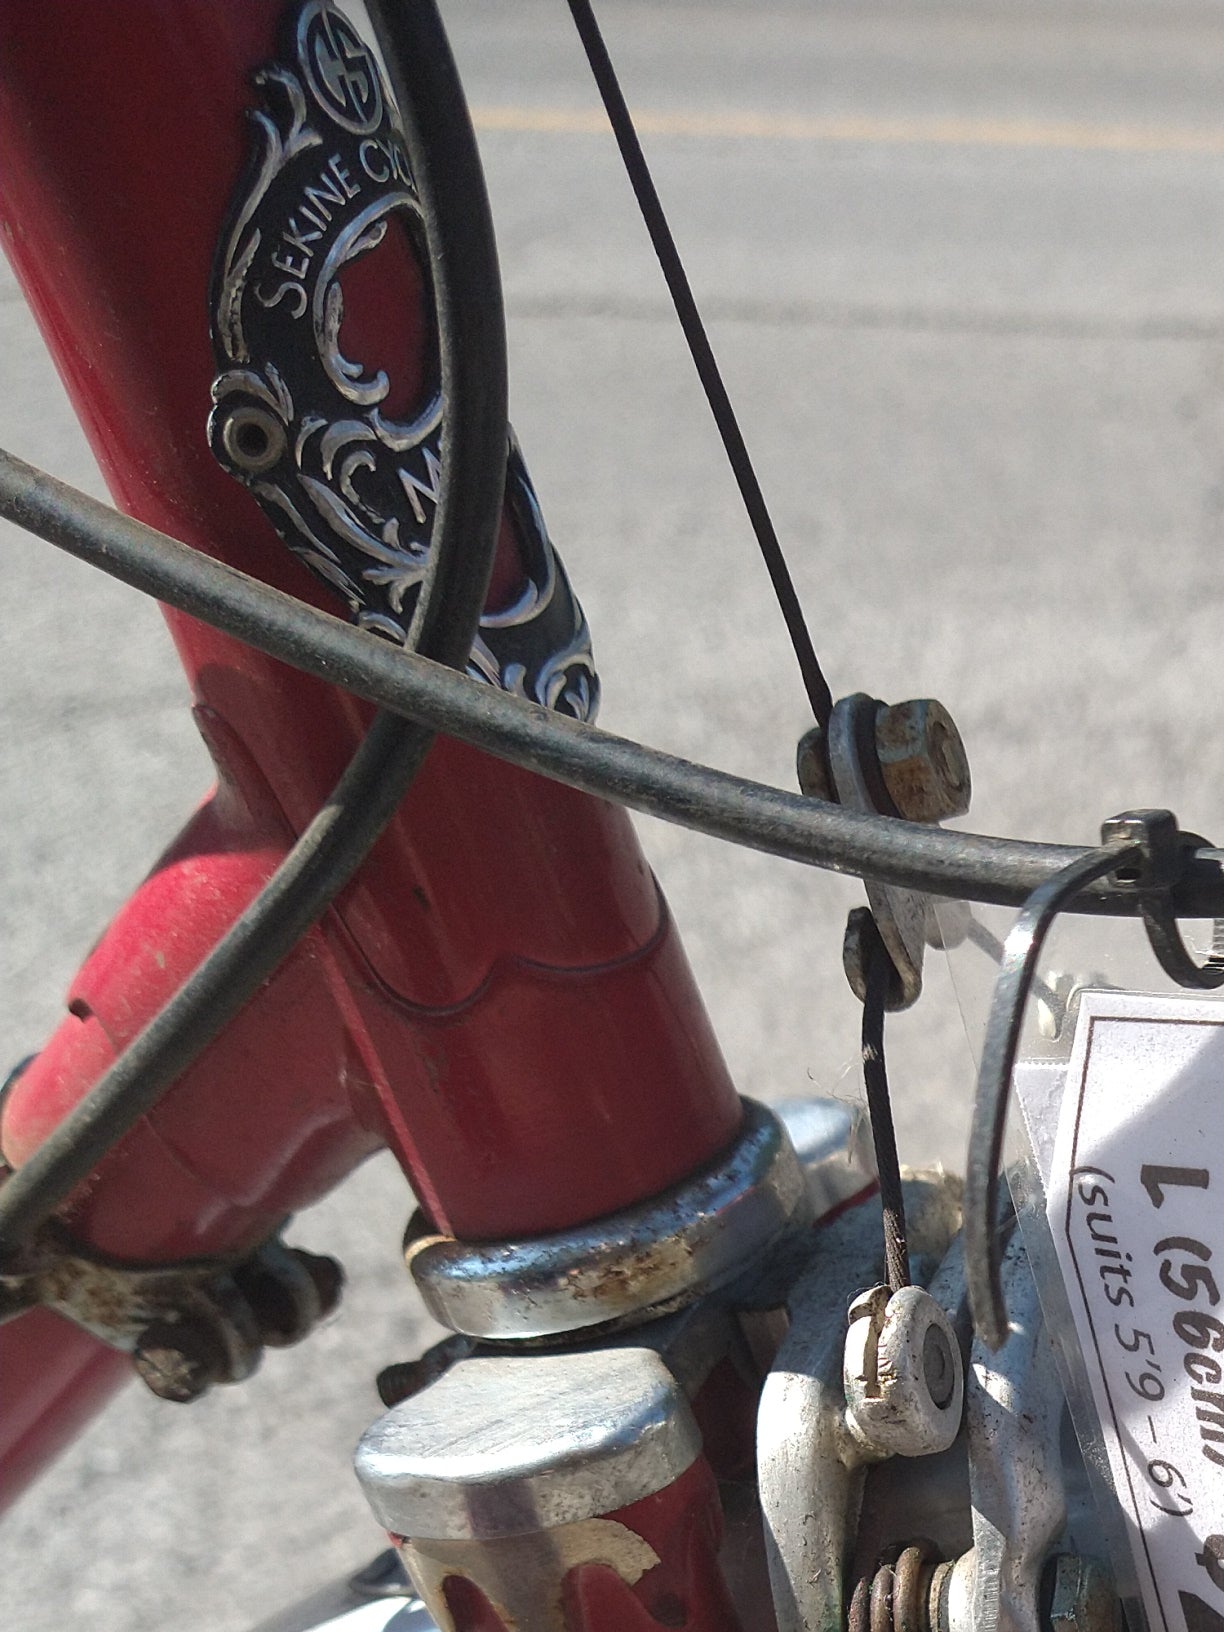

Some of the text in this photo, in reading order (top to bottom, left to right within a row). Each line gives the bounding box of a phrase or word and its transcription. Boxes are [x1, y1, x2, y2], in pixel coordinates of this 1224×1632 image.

[253, 152, 361, 319] SEKINE
[1140, 1163, 1210, 1209] L
[1070, 1165, 1136, 1308] (suits
[1114, 1323, 1166, 1402] 5'9
